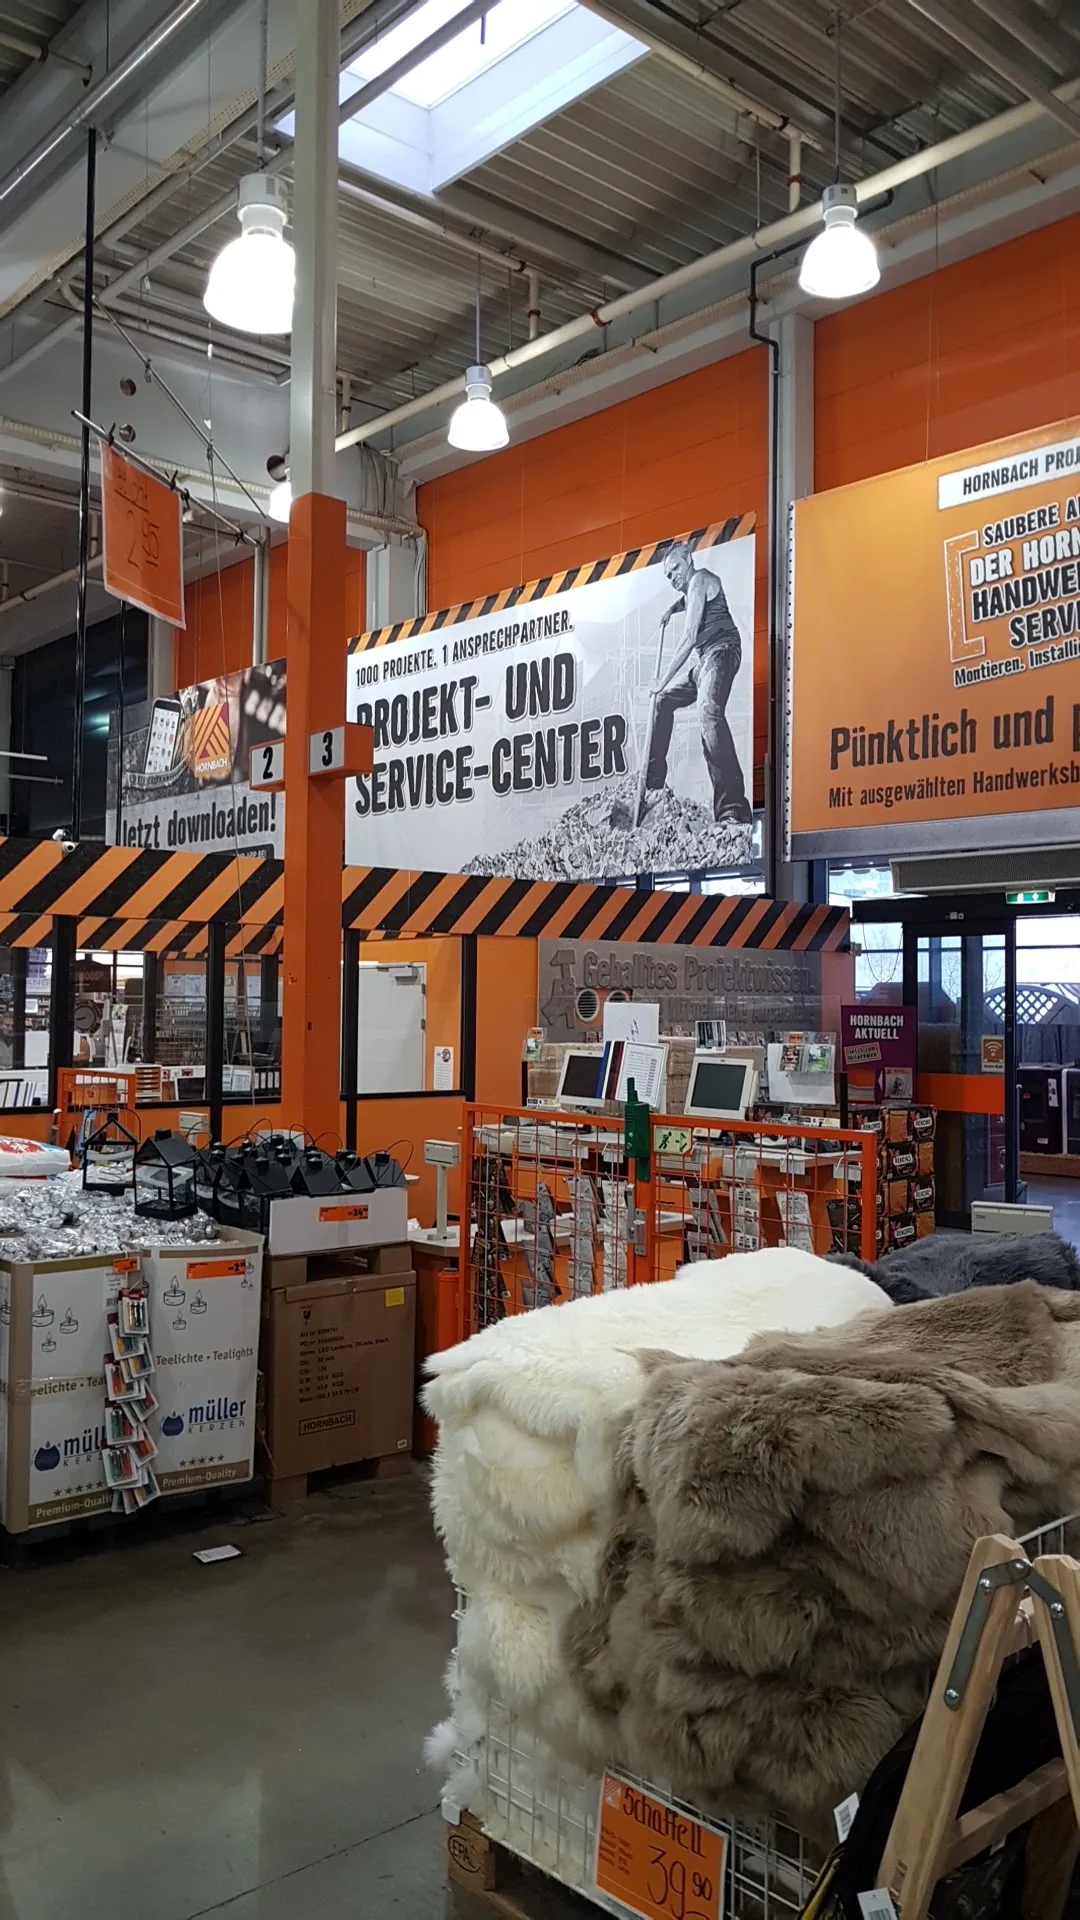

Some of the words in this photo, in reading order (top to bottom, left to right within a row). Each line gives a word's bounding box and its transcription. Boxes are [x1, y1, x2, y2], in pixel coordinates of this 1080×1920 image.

[963, 457, 1039, 496] HORNBACH
[983, 504, 1058, 546] SAUBERE
[1066, 496, 1080, 520] A
[970, 549, 1013, 587] DER
[972, 561, 1080, 621] HANDWE
[355, 667, 379, 688] 1000
[383, 650, 437, 682] PROJEKTE.
[442, 645, 448, 664] 1
[452, 609, 574, 663] ANSPRECHPARTNER.
[505, 652, 574, 720] UND
[954, 657, 1024, 687] Montieren.
[321, 731, 333, 767] 3
[830, 708, 977, 770] Pünktlich
[993, 695, 1055, 750] und
[262, 746, 274, 781] 2
[355, 713, 627, 816] SERVICE-CENTER
[829, 787, 853, 808] Mit
[860, 777, 965, 808] ausgewählten
[168, 792, 276, 847] downloaden!
[583, 950, 677, 989] Geballtes
[684, 955, 815, 995] Projektwissen.
[850, 1014, 904, 1027] HORNBACH
[854, 1027, 900, 1040] AKTUELL
[156, 1352, 204, 1366] Teelichte
[213, 1347, 254, 1362] Tealights
[30, 1380, 77, 1397] eelichte
[188, 1396, 246, 1424] müller
[188, 1420, 245, 1435] KERZEN
[303, 1414, 352, 1432] HORNBACH
[162, 1468, 237, 1488] Premium-Quality
